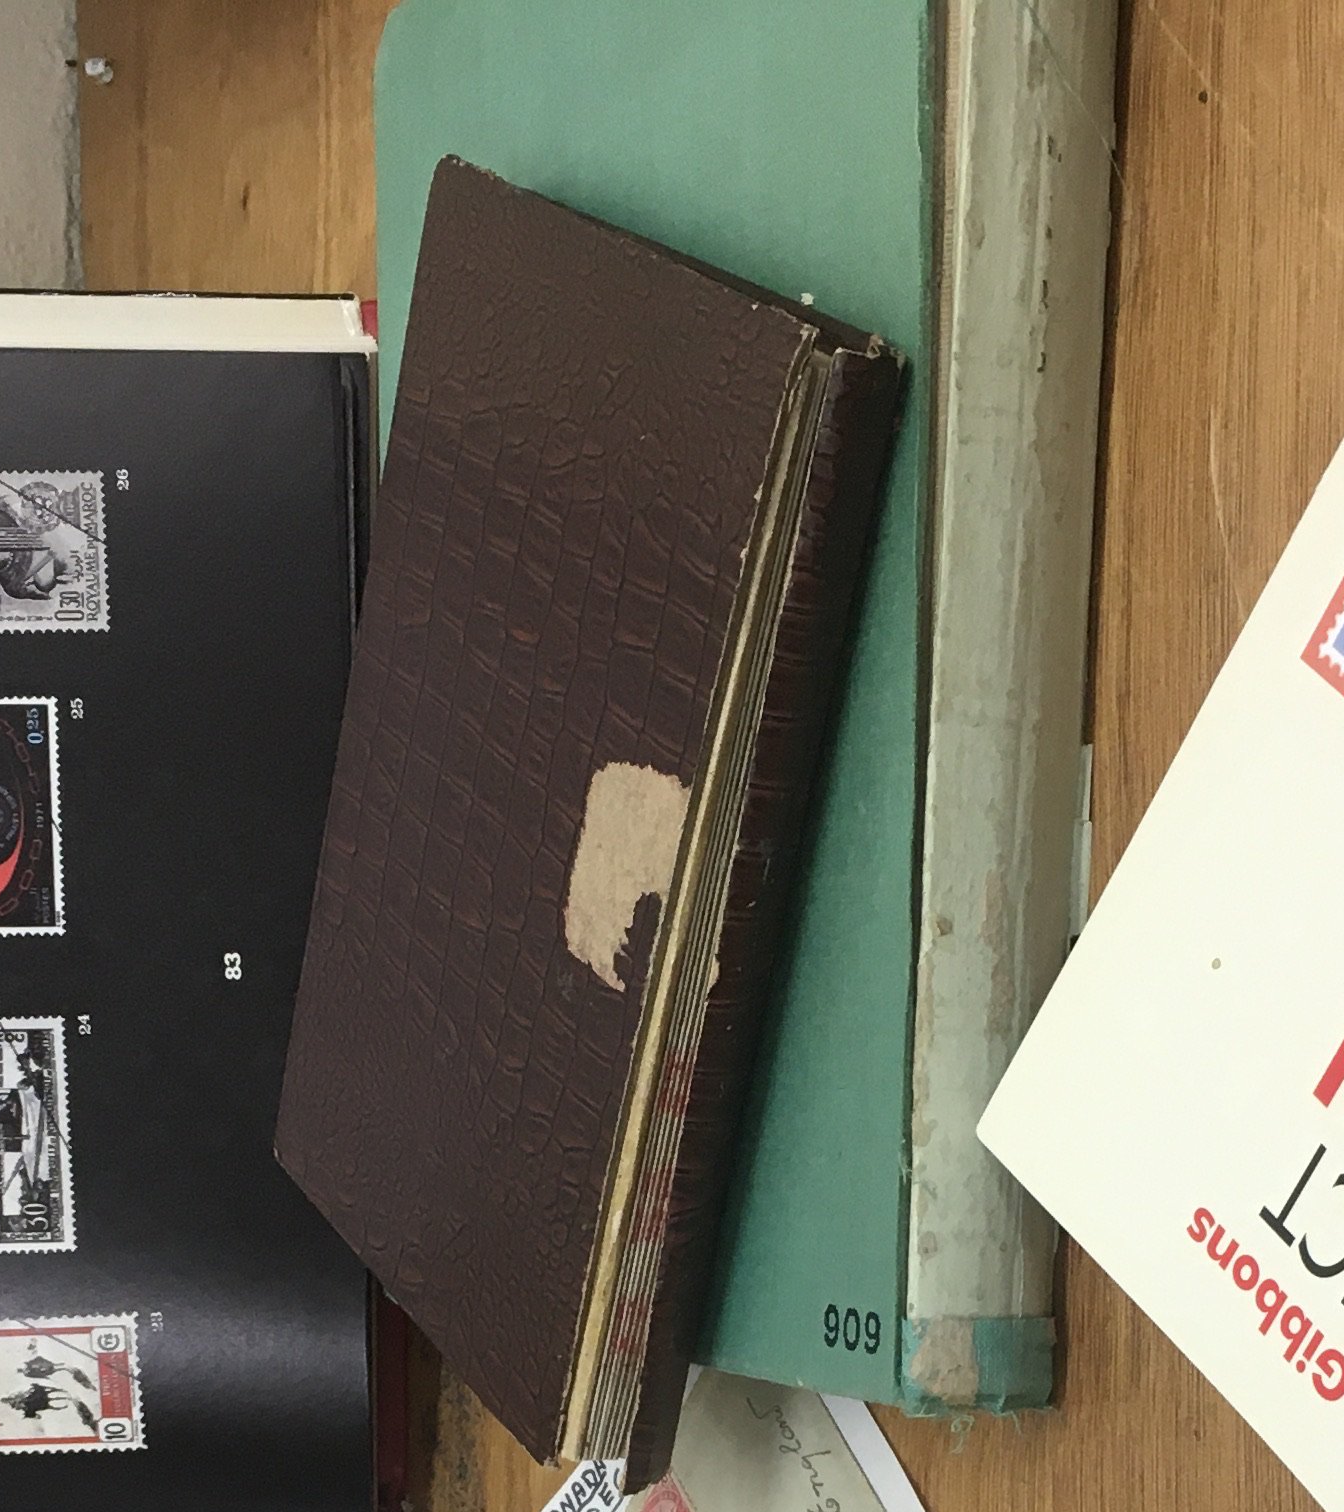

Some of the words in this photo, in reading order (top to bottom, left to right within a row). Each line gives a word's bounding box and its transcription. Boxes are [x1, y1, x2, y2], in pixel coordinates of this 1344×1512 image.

[79, 481, 96, 532] MAROC
[82, 552, 100, 622] ROYAUME
[70, 697, 84, 720] 25
[223, 952, 242, 981] 83
[77, 1014, 92, 1035] 24
[104, 1421, 128, 1441] 10
